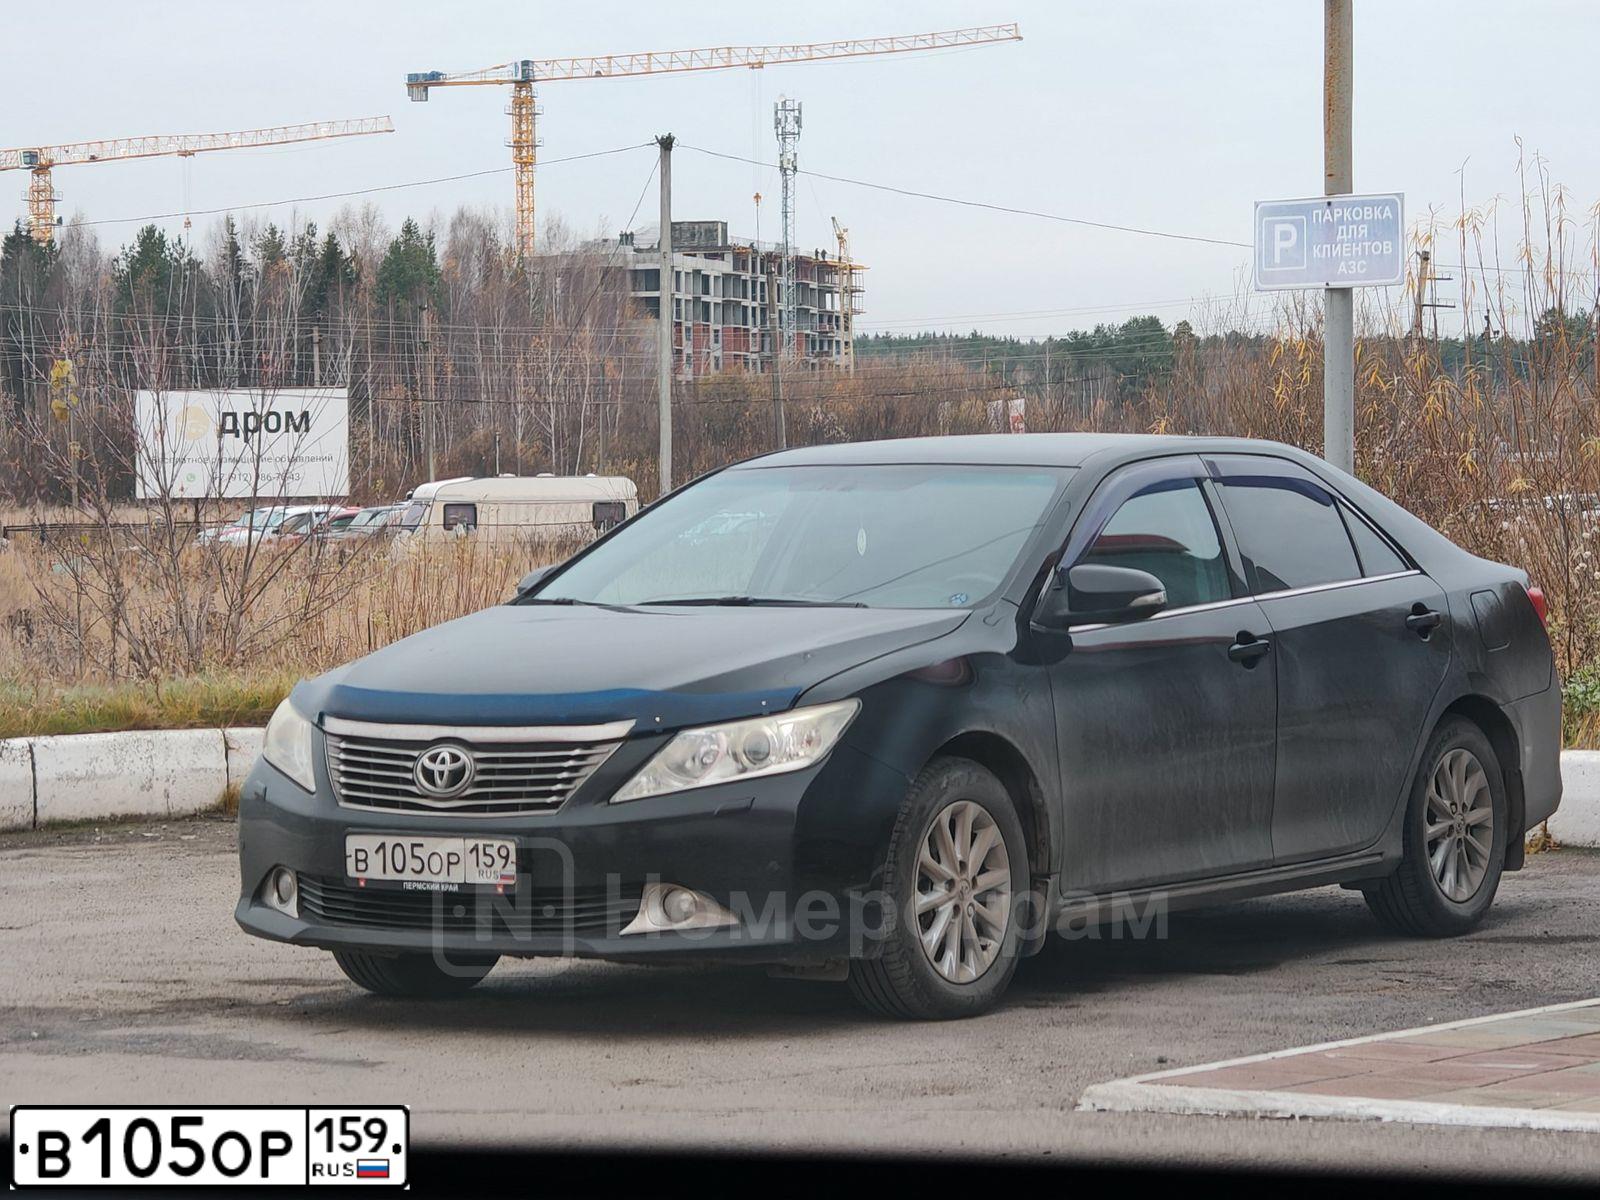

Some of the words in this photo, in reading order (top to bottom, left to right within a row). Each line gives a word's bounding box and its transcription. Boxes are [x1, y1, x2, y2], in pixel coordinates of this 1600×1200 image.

[1312, 206, 1393, 224] ПАРКОВКА
[1336, 224, 1368, 241] ДЛЯ
[1313, 241, 1393, 258] КЛИЕНТОВ
[1337, 260, 1367, 275] АЗС
[221, 410, 310, 443] дром
[211, 456, 272, 466] рзмщеие
[354, 841, 461, 876] В105ОР
[468, 843, 511, 869] 159
[478, 869, 500, 880] RUS
